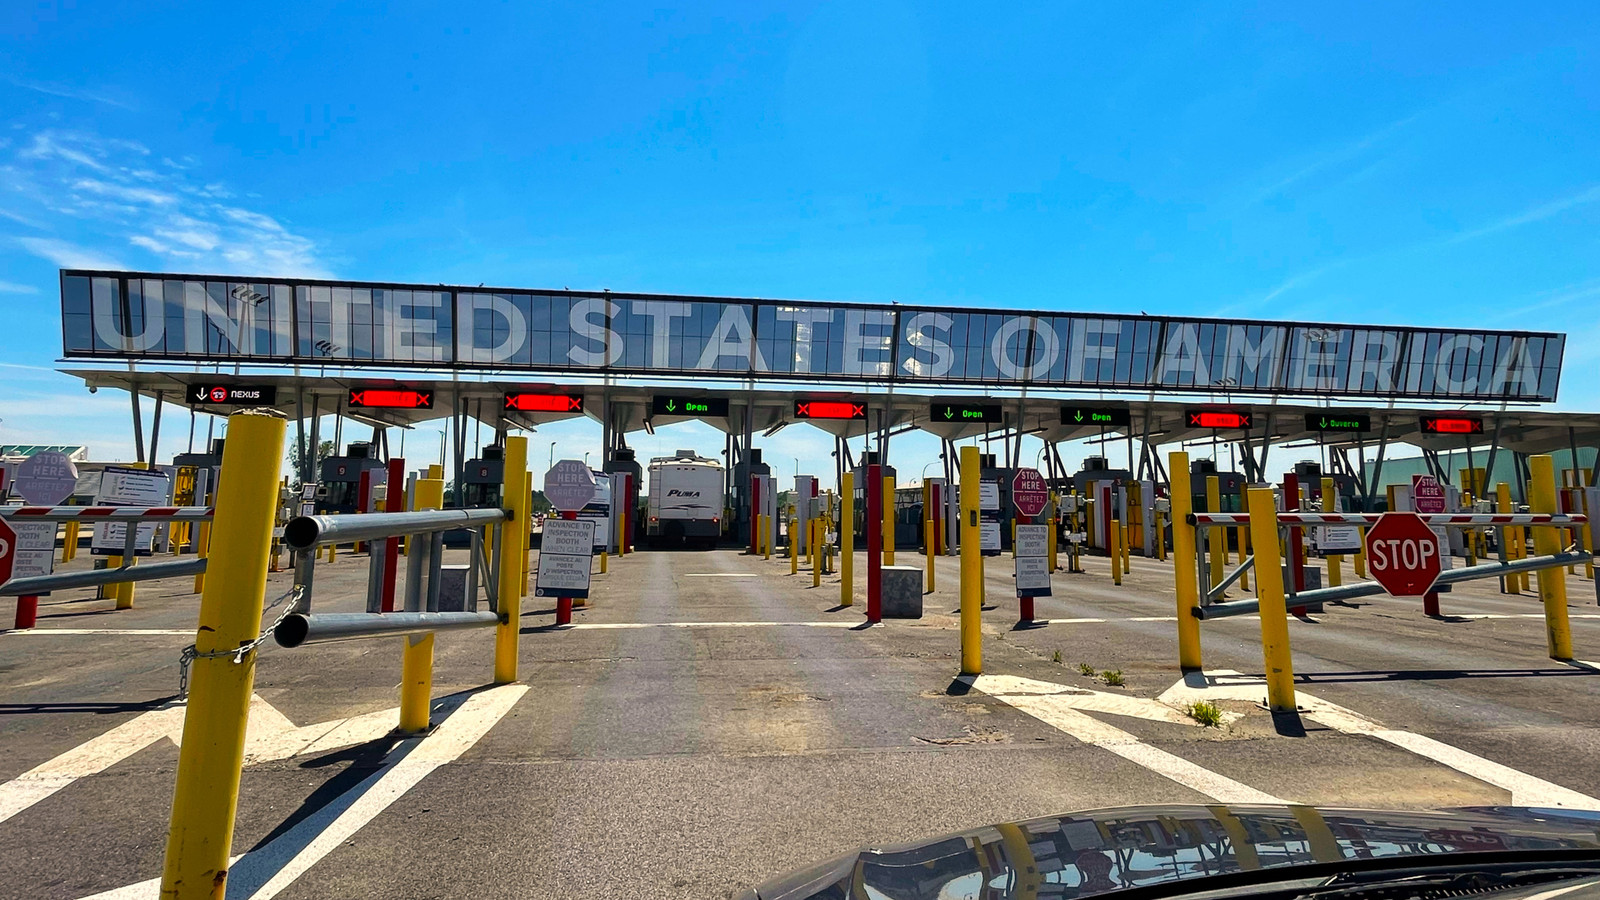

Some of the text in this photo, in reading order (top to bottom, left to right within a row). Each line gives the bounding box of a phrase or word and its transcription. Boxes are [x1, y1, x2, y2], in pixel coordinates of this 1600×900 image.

[92, 276, 1540, 396] UNITED STATES OF AMERICA
[231, 390, 260, 399] NEXUS
[686, 403, 708, 412] Open
[962, 409, 983, 418] Open
[1092, 413, 1112, 422] Open
[34, 454, 66, 465] STOP
[33, 465, 66, 477] HERE
[558, 463, 584, 473] STOP
[557, 473, 584, 483] HERE
[1021, 471, 1039, 480] STOP
[1021, 481, 1040, 490] HERE
[1421, 478, 1437, 487] STOP
[667, 489, 700, 498] PUMA
[1421, 487, 1439, 496] HERE
[547, 521, 580, 530] ADVANCE
[19, 532, 40, 540] OOTH
[548, 530, 589, 538] INSPECTION
[556, 537, 580, 545] BOOTH
[567, 546, 589, 554] CLEAR
[1372, 538, 1435, 571] STOP
